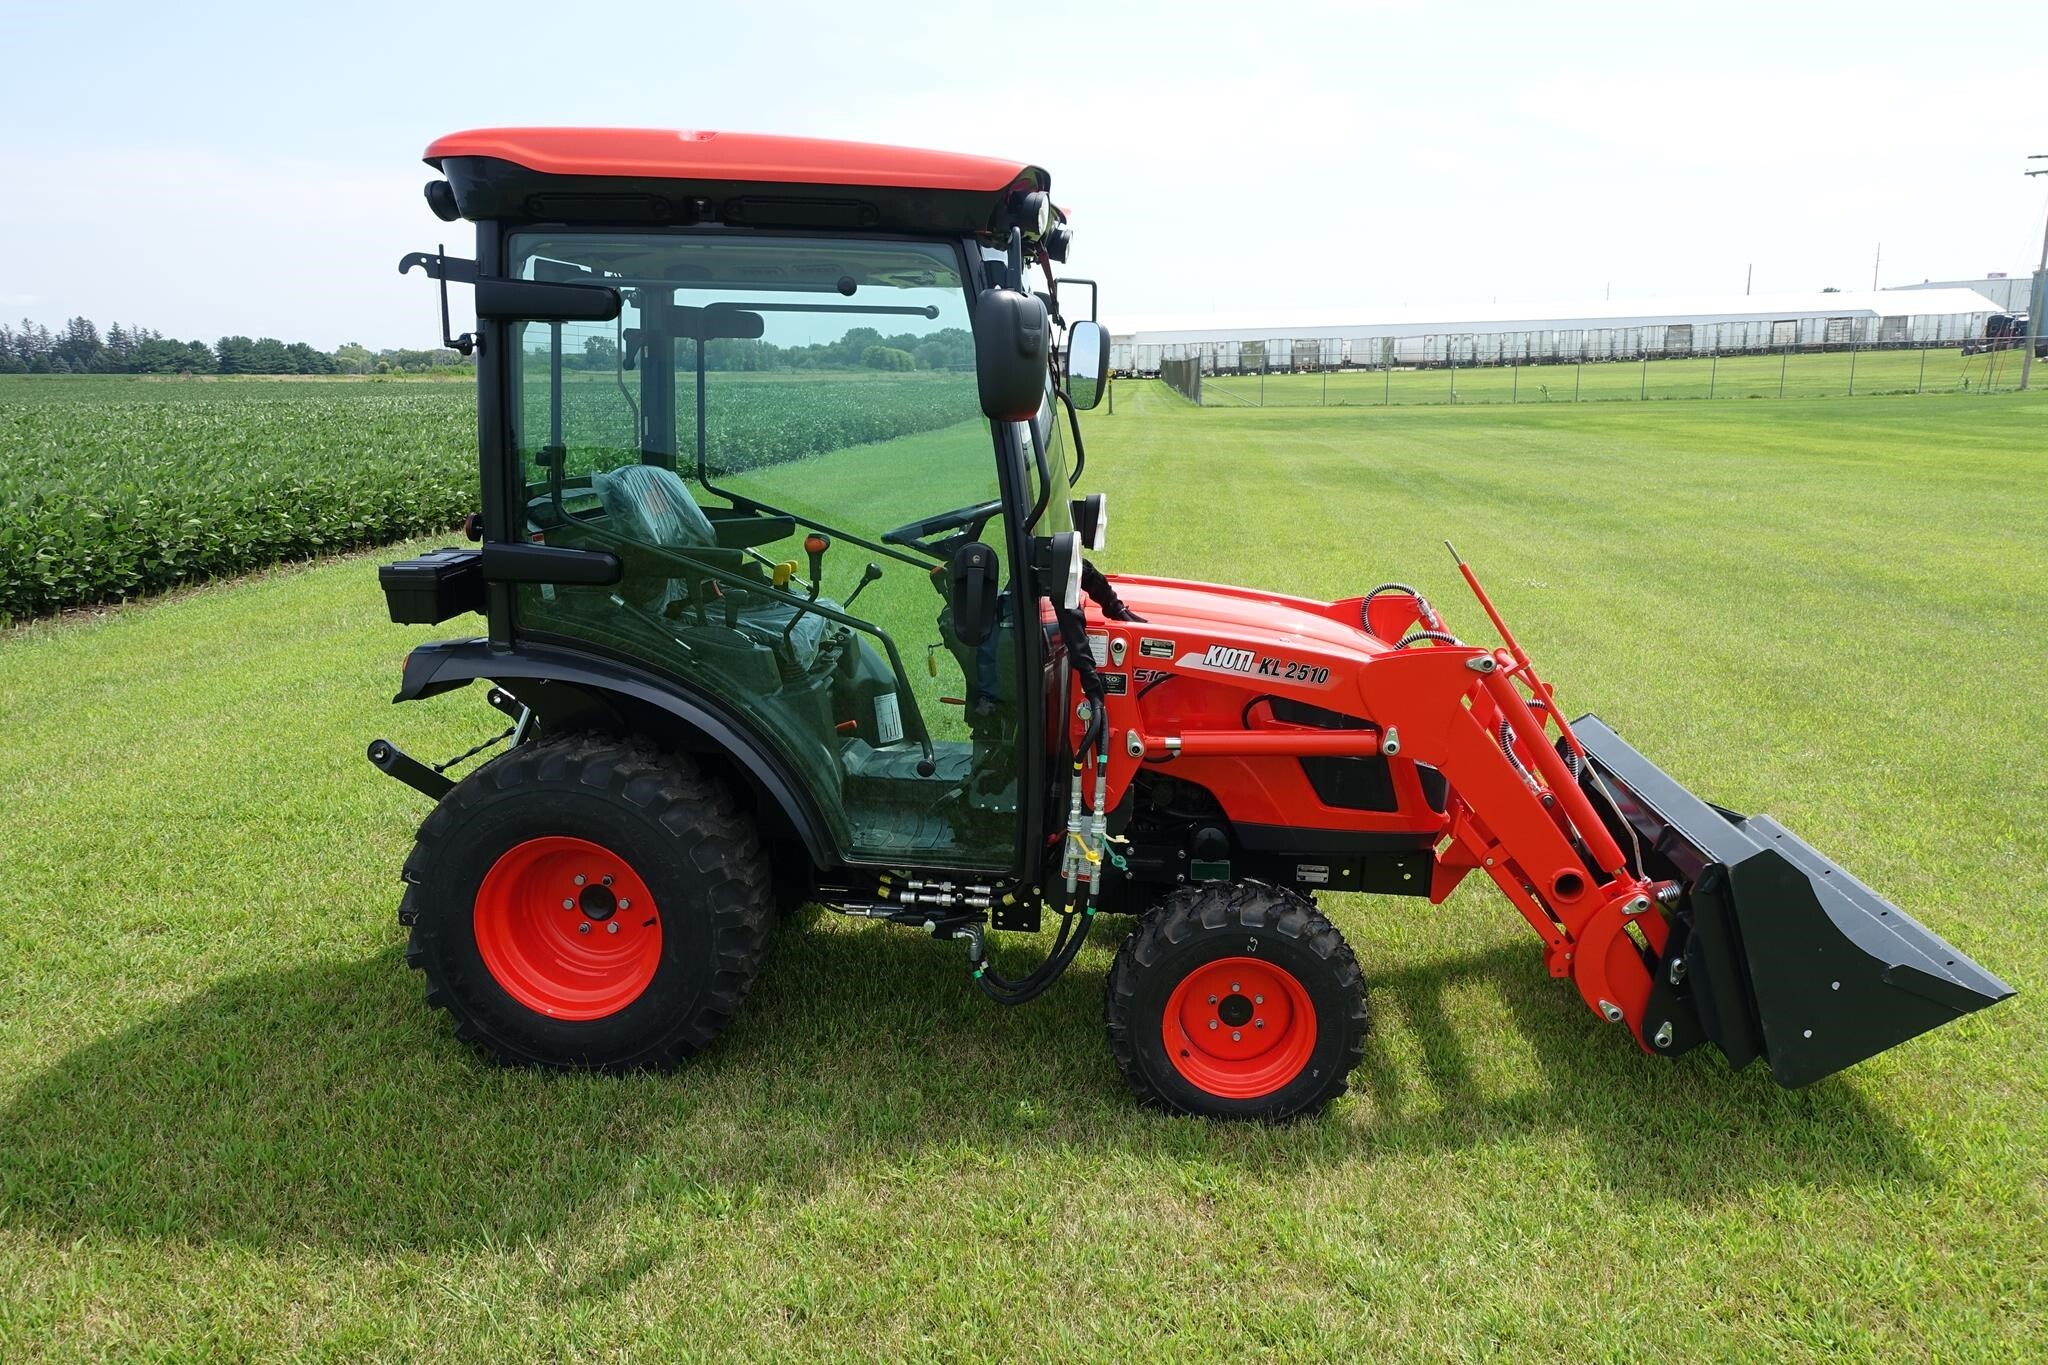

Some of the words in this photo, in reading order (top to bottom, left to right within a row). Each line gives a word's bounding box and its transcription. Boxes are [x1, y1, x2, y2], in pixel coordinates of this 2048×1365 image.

[1203, 644, 1256, 672] KIOTI
[1258, 657, 1280, 677] KL
[1285, 662, 1329, 684] 2510
